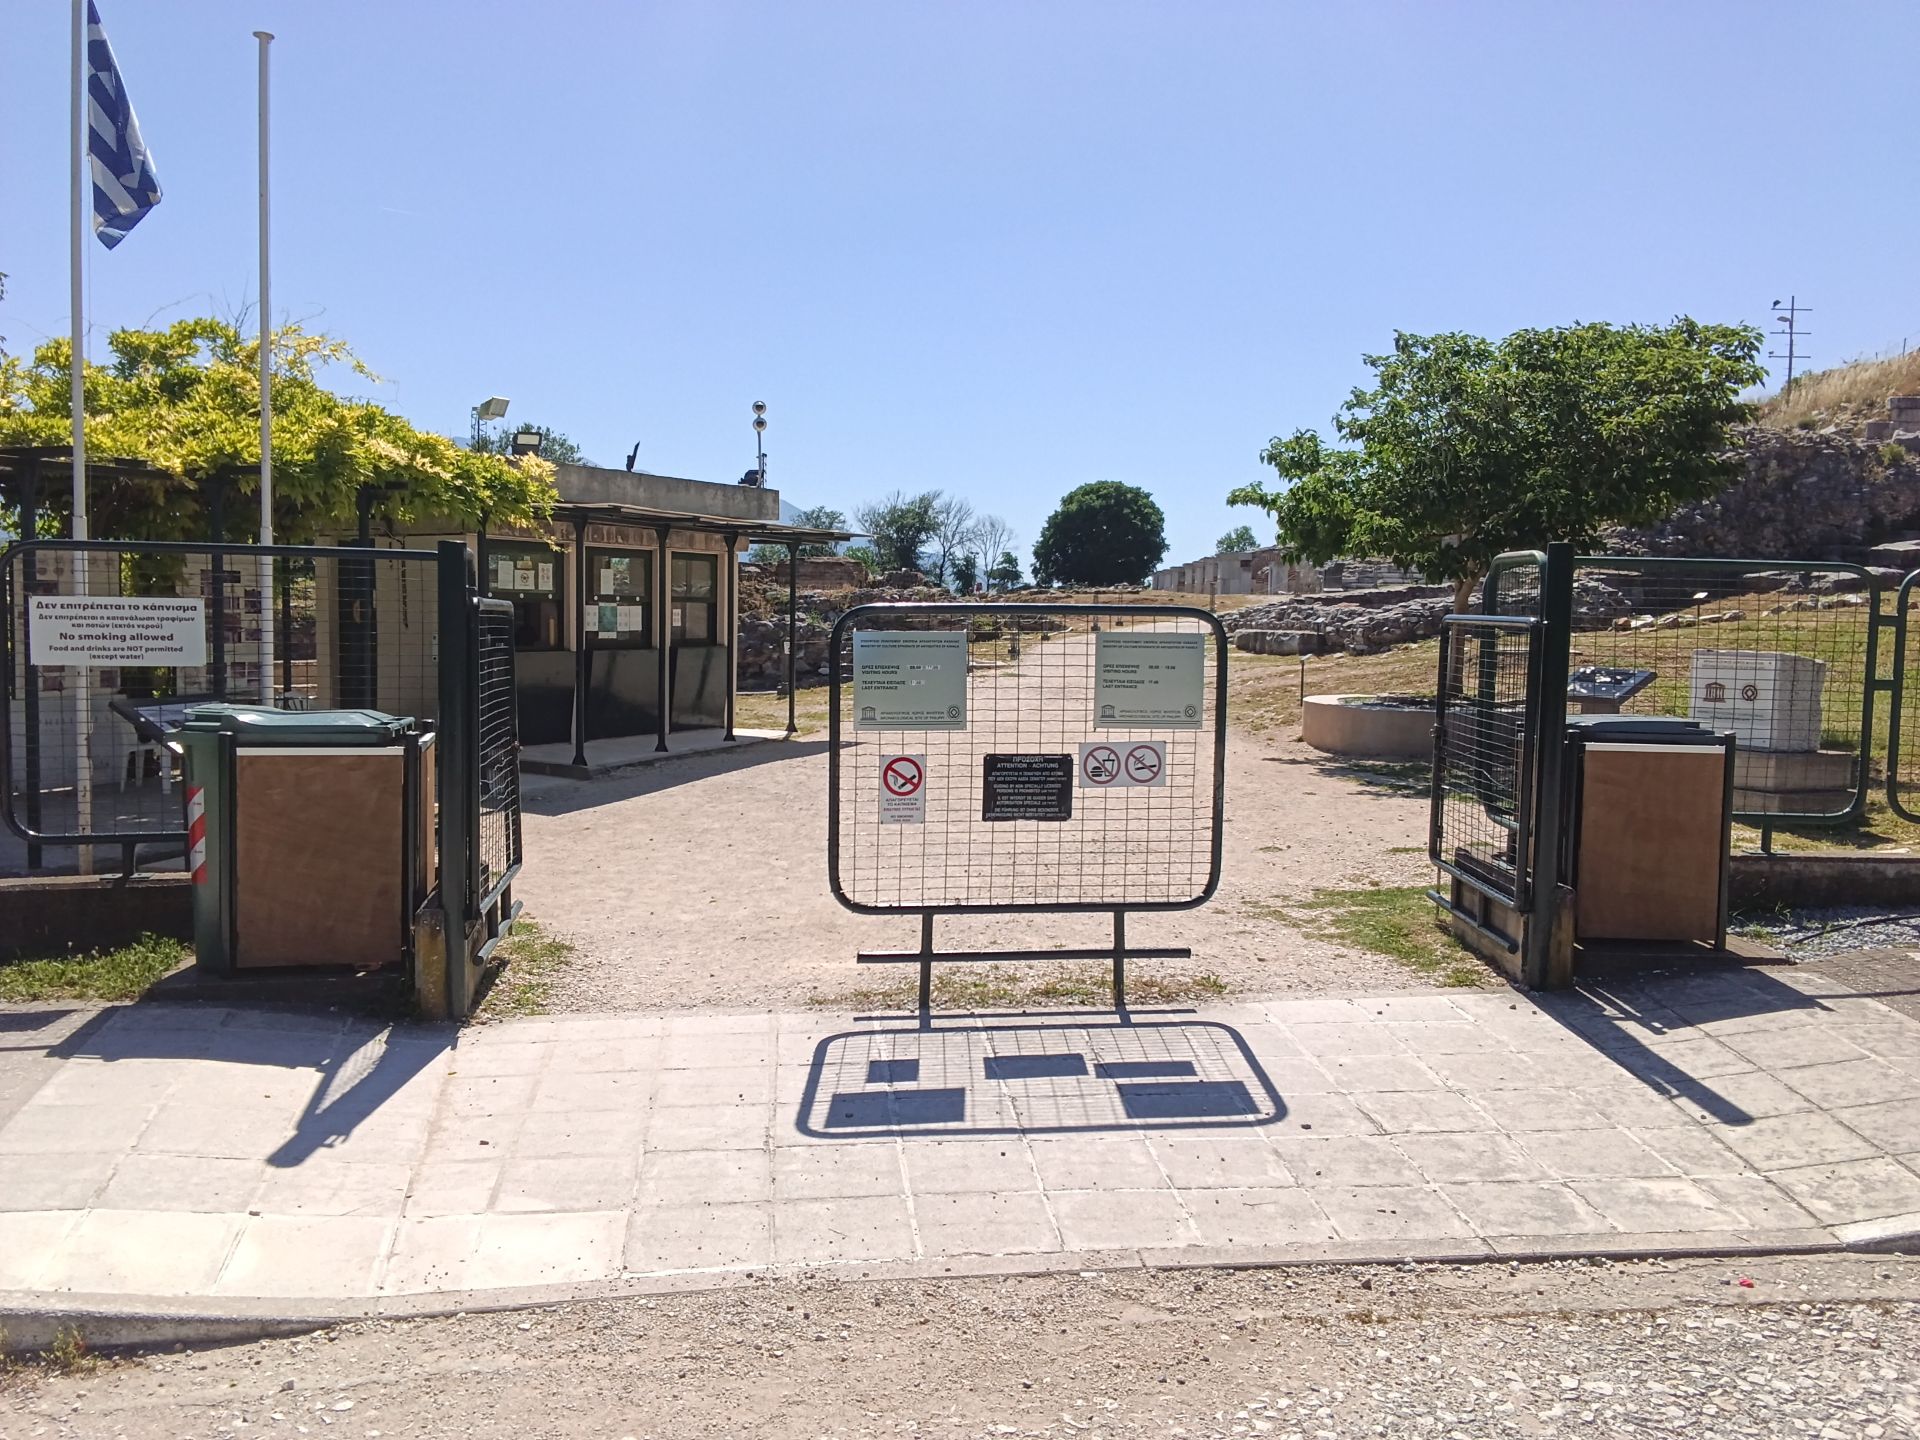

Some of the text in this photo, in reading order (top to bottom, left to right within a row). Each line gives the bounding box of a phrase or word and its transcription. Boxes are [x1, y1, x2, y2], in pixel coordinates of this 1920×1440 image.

[36, 601, 57, 609] Δεν
[60, 601, 125, 611] επιτρέπεται
[143, 602, 197, 614] κάπνισμα
[59, 632, 173, 643] No smoking allowed
[119, 653, 144, 661] water)
